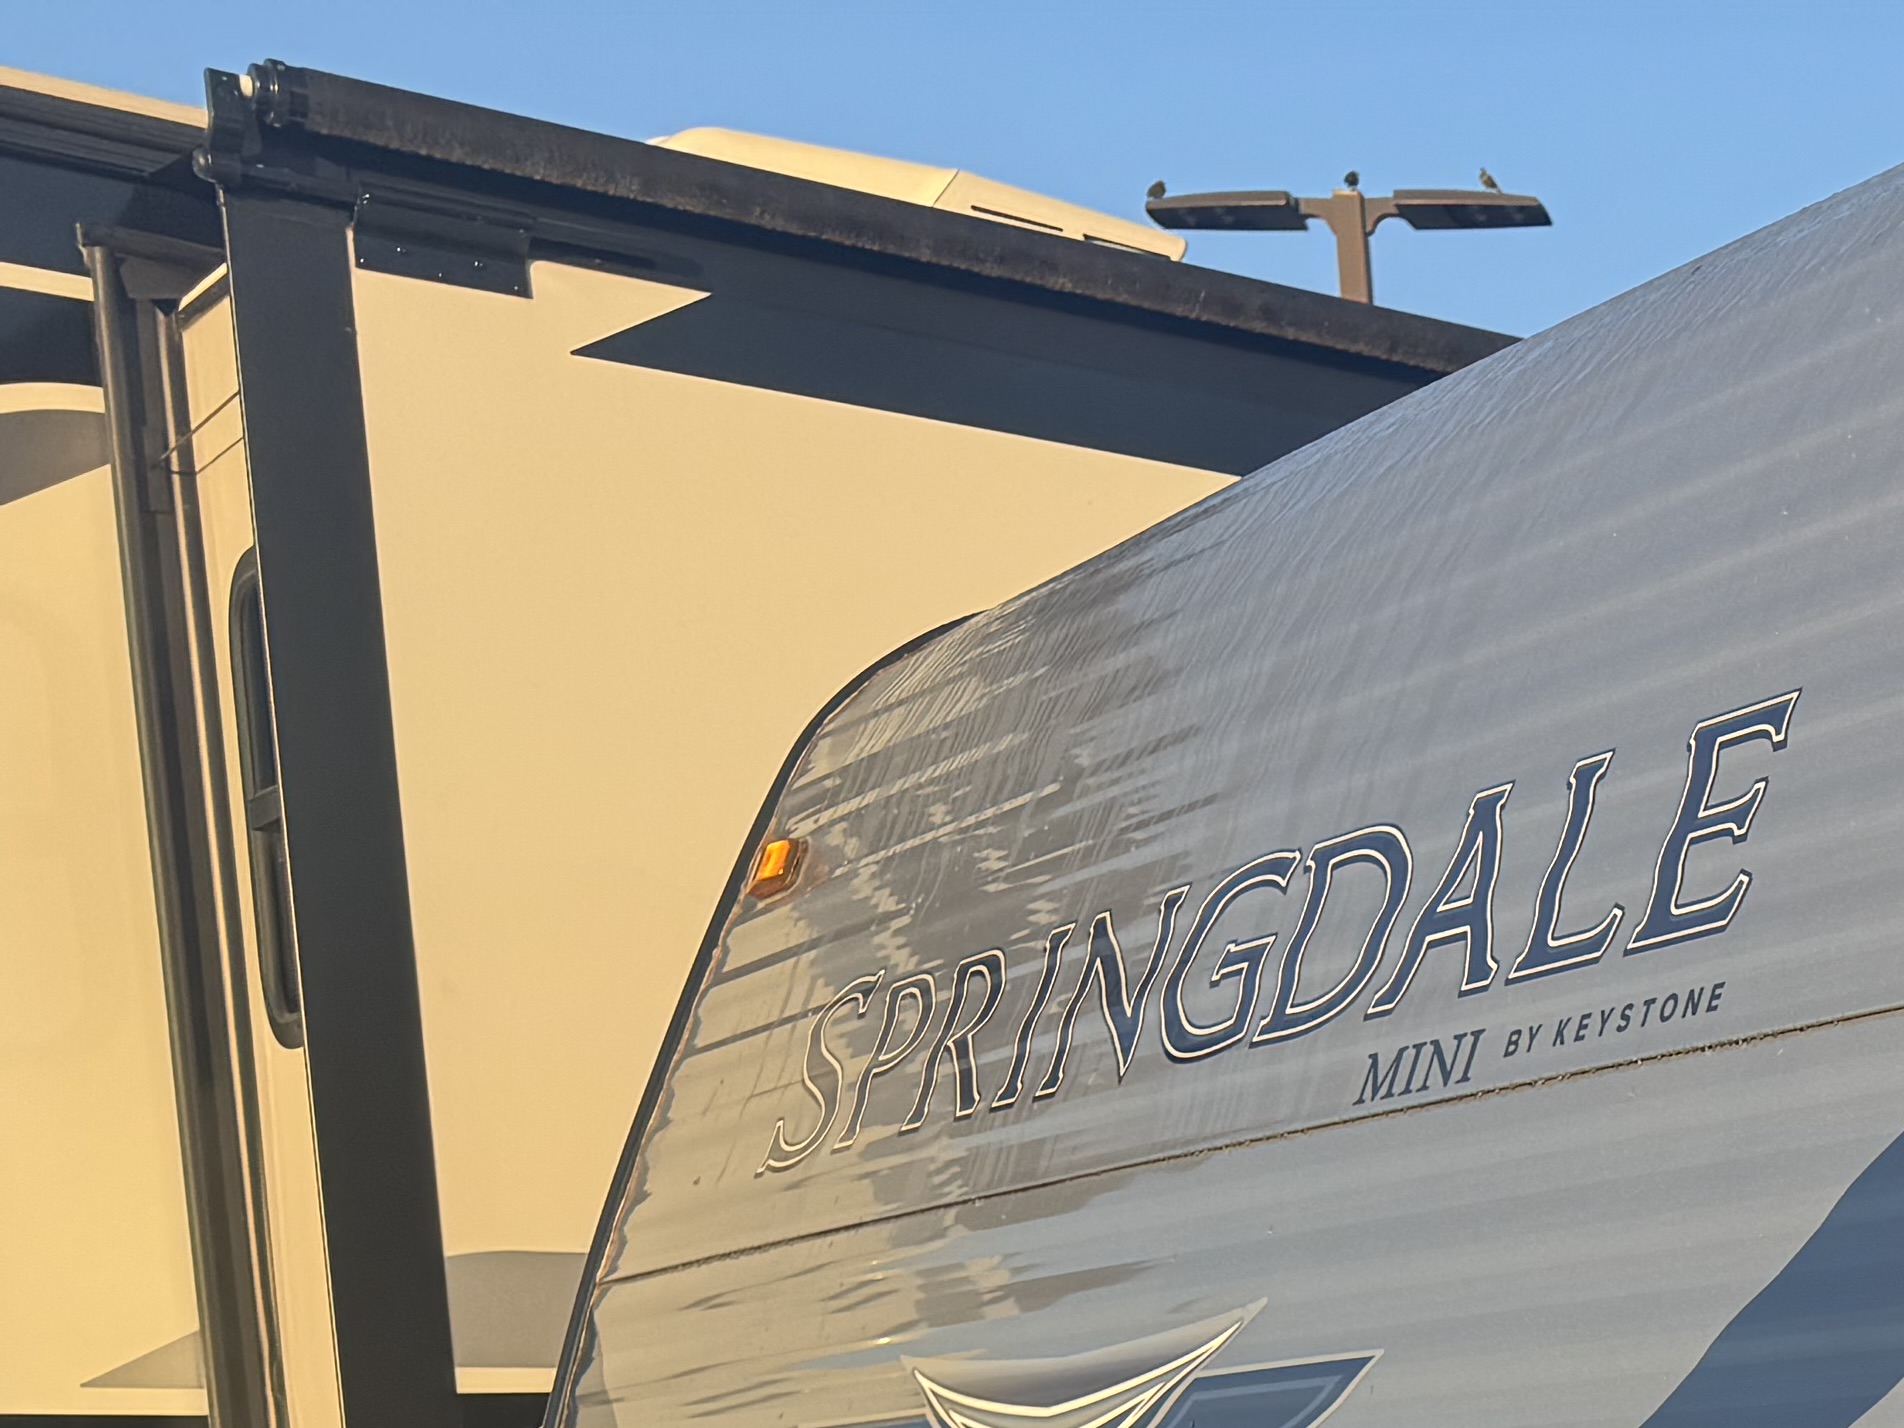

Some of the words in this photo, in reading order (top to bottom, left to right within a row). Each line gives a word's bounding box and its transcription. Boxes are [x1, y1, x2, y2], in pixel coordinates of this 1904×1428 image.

[758, 686, 1803, 1178] SPRINGDALE
[1352, 1027, 1488, 1107] MINI
[1503, 1021, 1545, 1060] BY
[1552, 981, 1727, 1049] KEYSTONE
